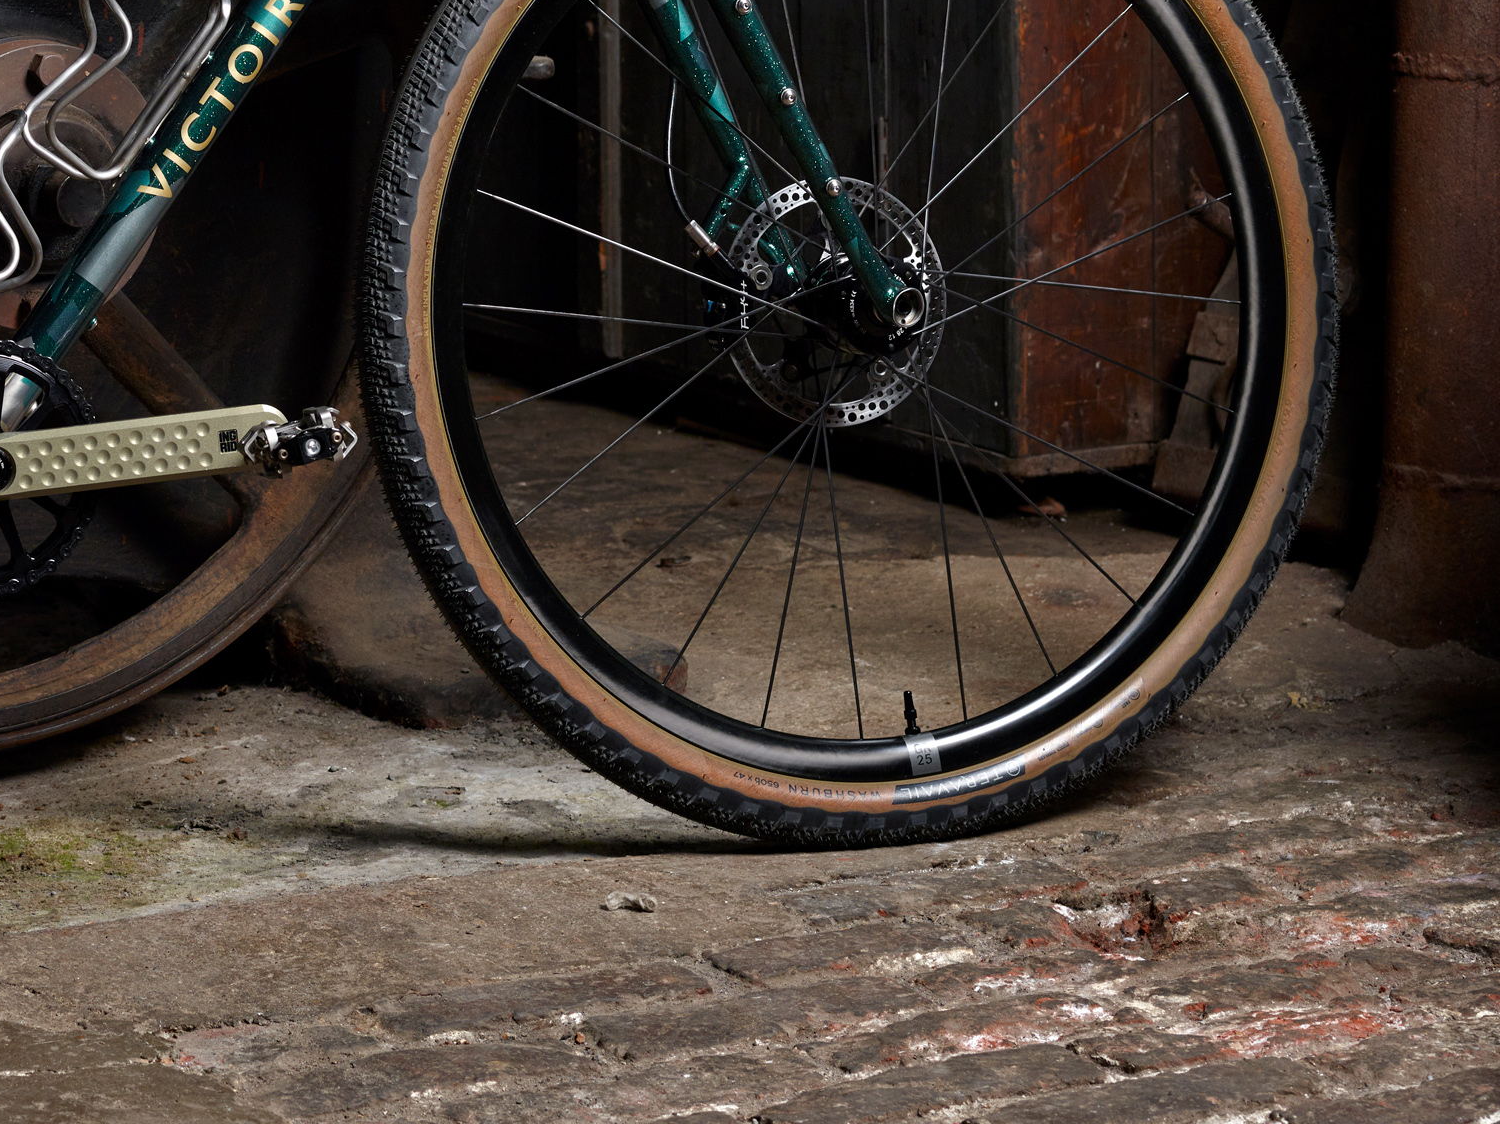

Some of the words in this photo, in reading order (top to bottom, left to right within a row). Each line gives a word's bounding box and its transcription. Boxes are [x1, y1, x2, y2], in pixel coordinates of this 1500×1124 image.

[1206, 17, 1221, 33] IN
[422, 258, 430, 307] INFLATED
[219, 430, 238, 442] ING
[219, 441, 238, 453] RID
[916, 754, 933, 766] 25
[733, 770, 745, 780] 47
[754, 777, 779, 788] 650b
[900, 769, 1003, 802] TERAVAIL
[787, 783, 880, 799] WASHBURN
